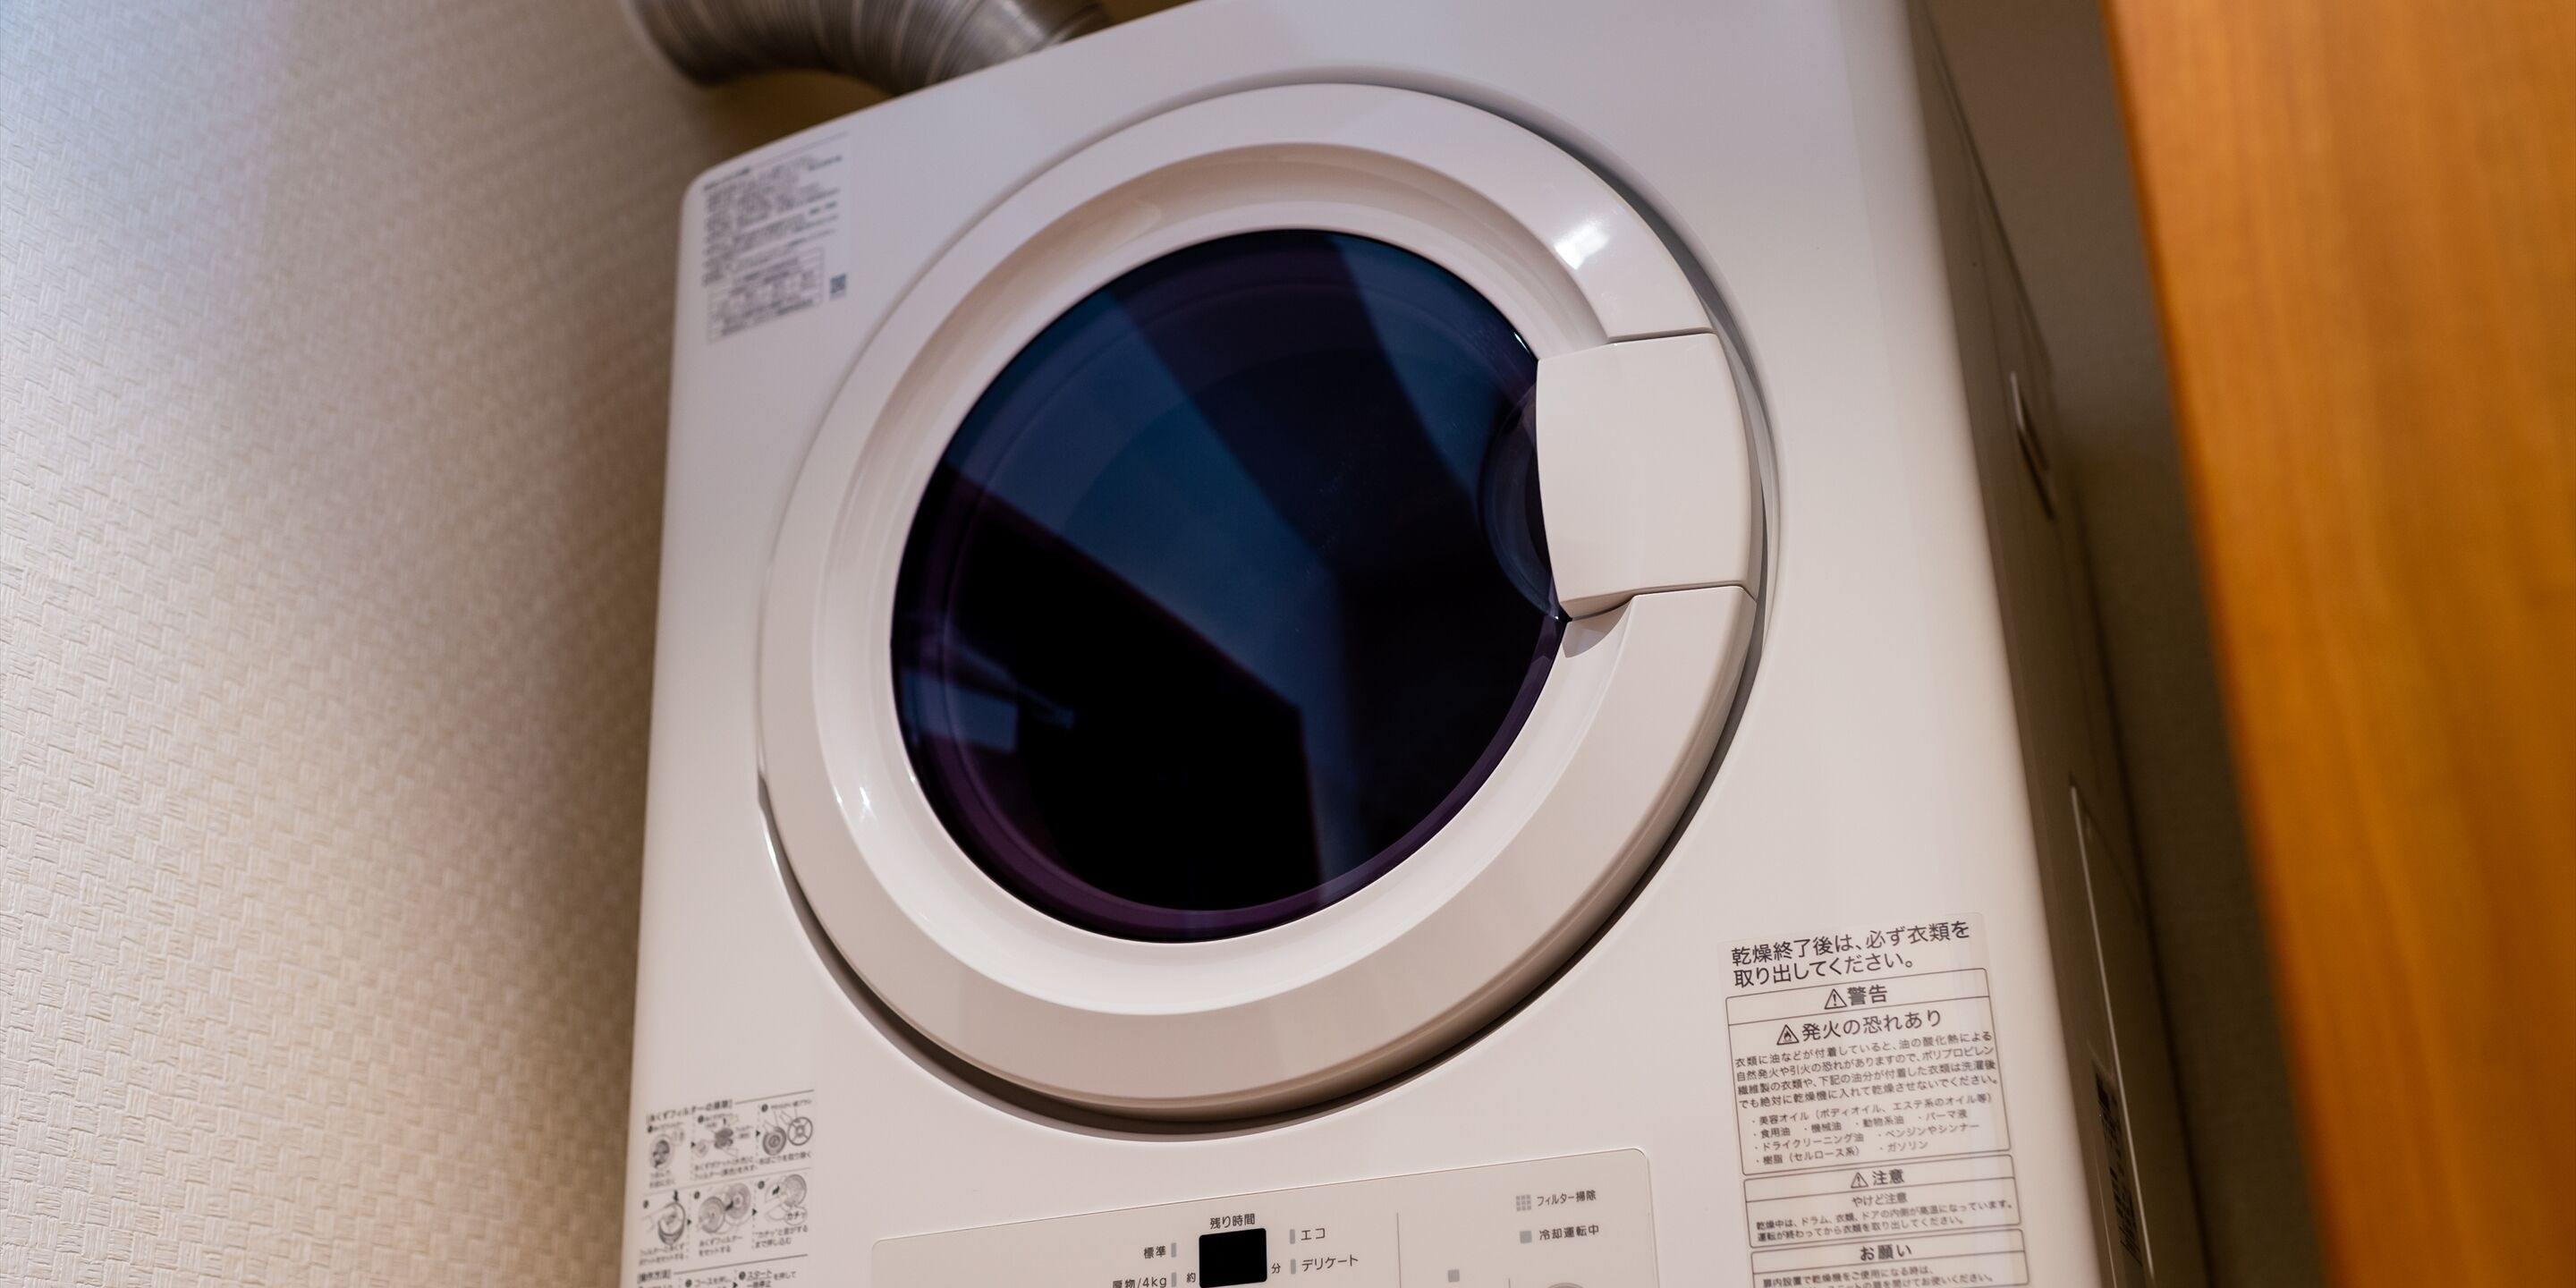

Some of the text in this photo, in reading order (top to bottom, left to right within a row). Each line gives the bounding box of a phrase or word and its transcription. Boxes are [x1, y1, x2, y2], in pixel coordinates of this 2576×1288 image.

[1732, 920, 1970, 965] 乾燥終了後は、必ず衣類を
[1733, 953, 1912, 987] 取り出してください。
[1846, 984, 1888, 1005] 警告
[1801, 1009, 1941, 1042] 発火の恐れあり
[1872, 1168, 1905, 1186] 注意
[1536, 1190, 1597, 1208] フィルター掃除
[1852, 1191, 1907, 1207] やけど注意
[1209, 1213, 1256, 1230] 残り時間
[1301, 1227, 1326, 1241] エコ
[1539, 1224, 1599, 1241] 冷却運転中
[1143, 1245, 1167, 1260] 標準
[1860, 1243, 1912, 1262] お願い
[1271, 1262, 1282, 1275] 分
[1301, 1255, 1359, 1272] デリケート
[1186, 1272, 1197, 1284] 約
